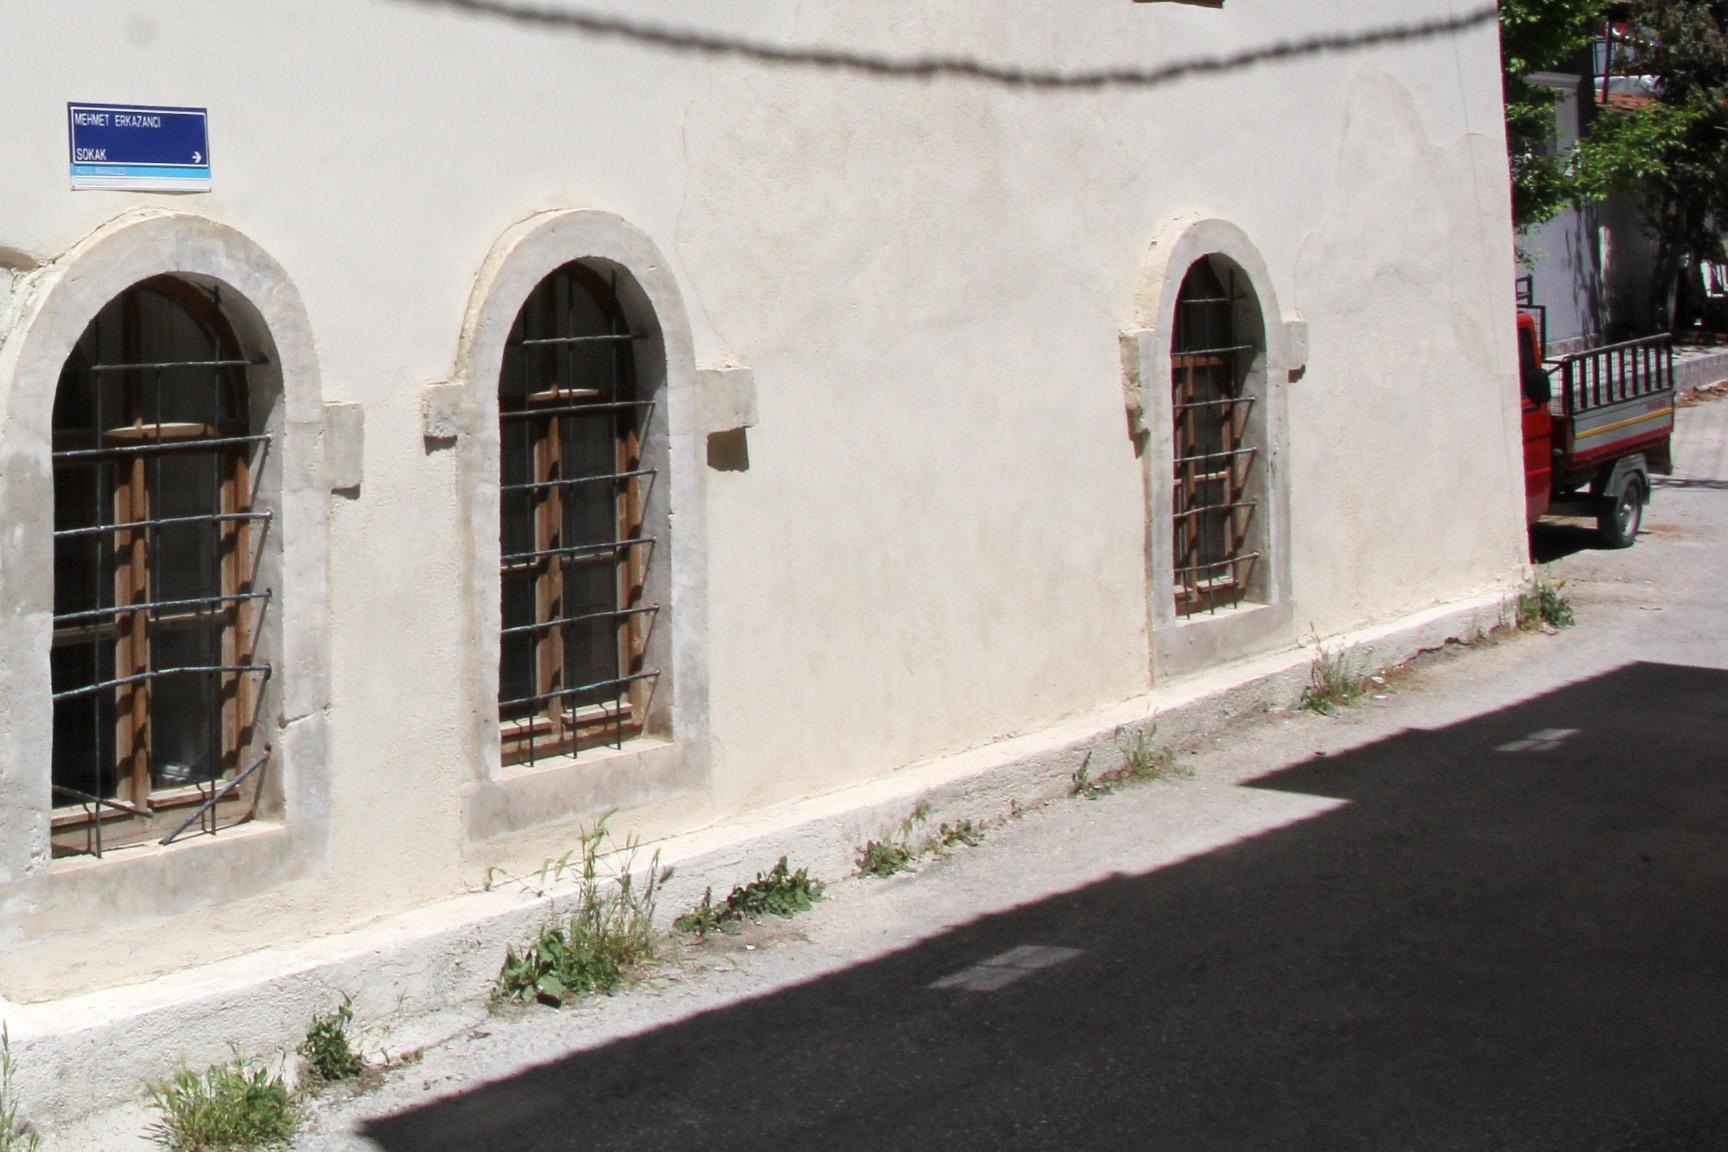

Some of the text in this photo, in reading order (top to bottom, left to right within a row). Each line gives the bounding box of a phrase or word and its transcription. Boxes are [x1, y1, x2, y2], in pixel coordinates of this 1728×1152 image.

[75, 113, 161, 128] MEHMET ERKAZANCI
[76, 148, 107, 161] SOKAK
